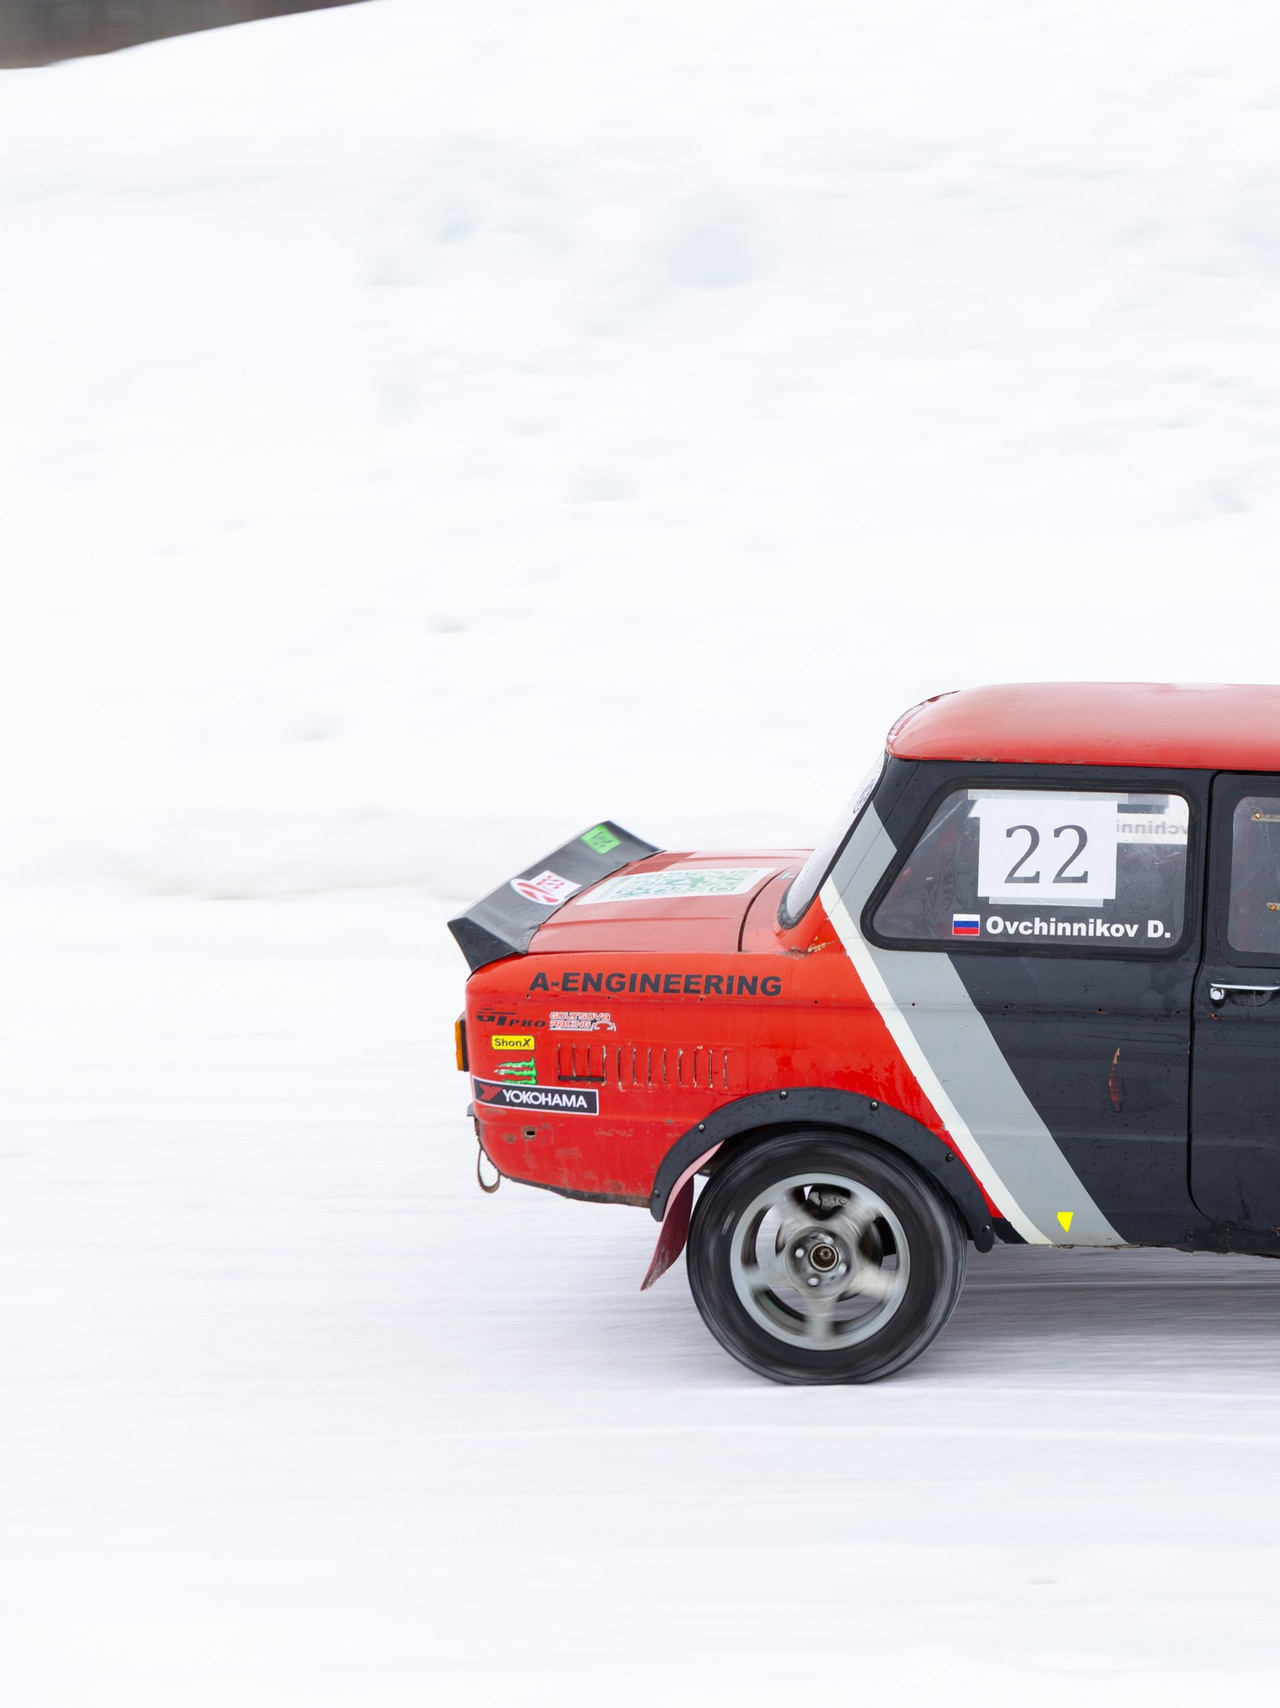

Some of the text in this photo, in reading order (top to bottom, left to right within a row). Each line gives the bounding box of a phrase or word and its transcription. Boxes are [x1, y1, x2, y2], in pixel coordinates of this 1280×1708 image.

[1004, 824, 1089, 885] 22
[985, 916, 1171, 939] Ovchinnikov D.
[529, 972, 782, 996] A-ENGINEERING
[494, 1038, 531, 1047] ShonX
[502, 1088, 588, 1109] YOKOHAMA
